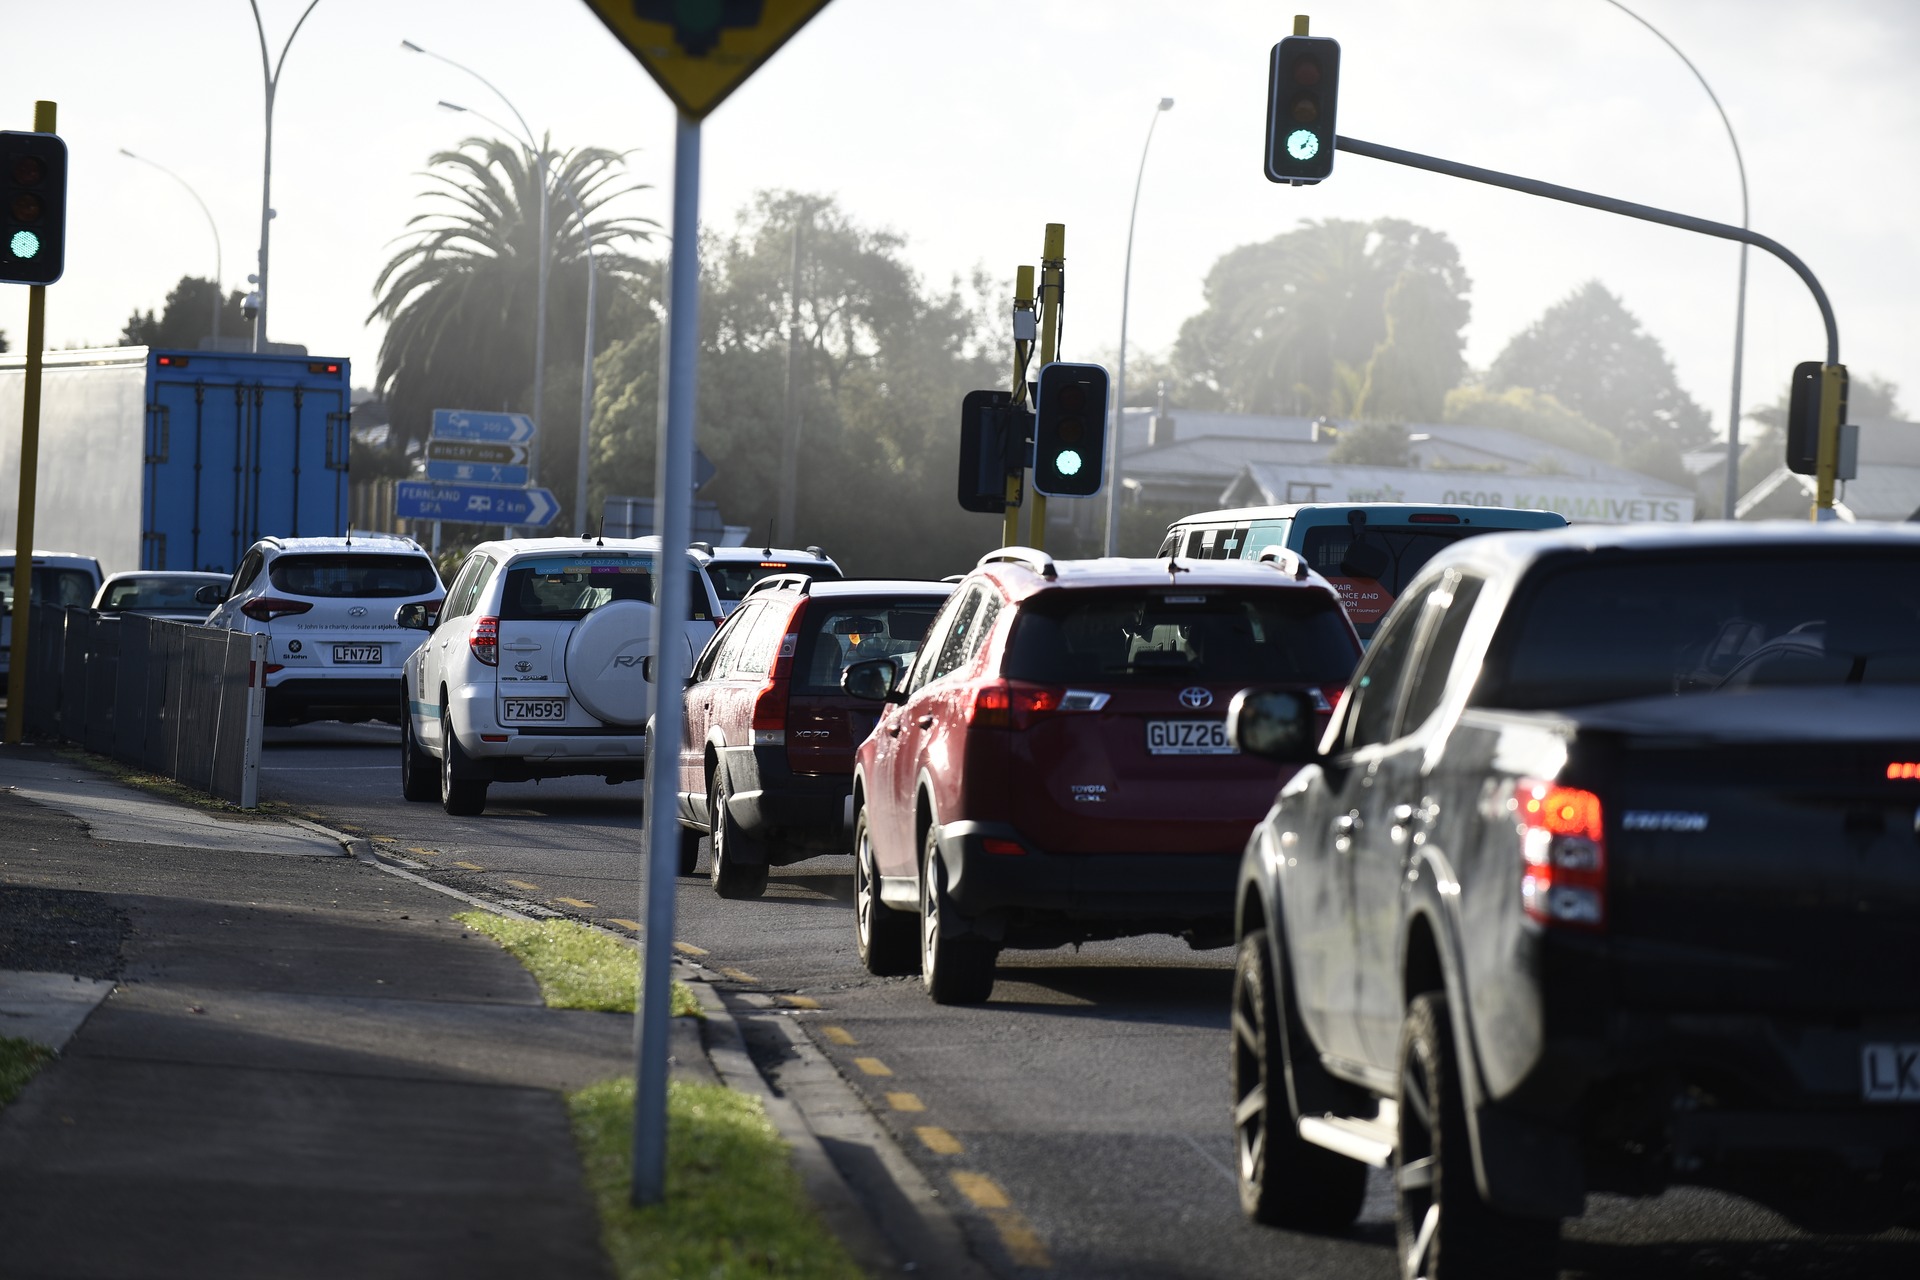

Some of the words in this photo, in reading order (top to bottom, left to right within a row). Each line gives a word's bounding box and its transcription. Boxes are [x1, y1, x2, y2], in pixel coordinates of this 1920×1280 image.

[434, 447, 474, 457] WINERY
[402, 487, 460, 501] FERNLAND
[1442, 489, 1502, 507] 0508
[420, 502, 441, 513] SPA
[496, 500, 505, 512] 2
[507, 501, 526, 513] km
[335, 648, 380, 661] LFN772
[506, 702, 563, 718] FZM593
[1150, 724, 1230, 747] GUZ26
[1072, 785, 1107, 793] TOYOTA
[1869, 1051, 1920, 1092] LK
